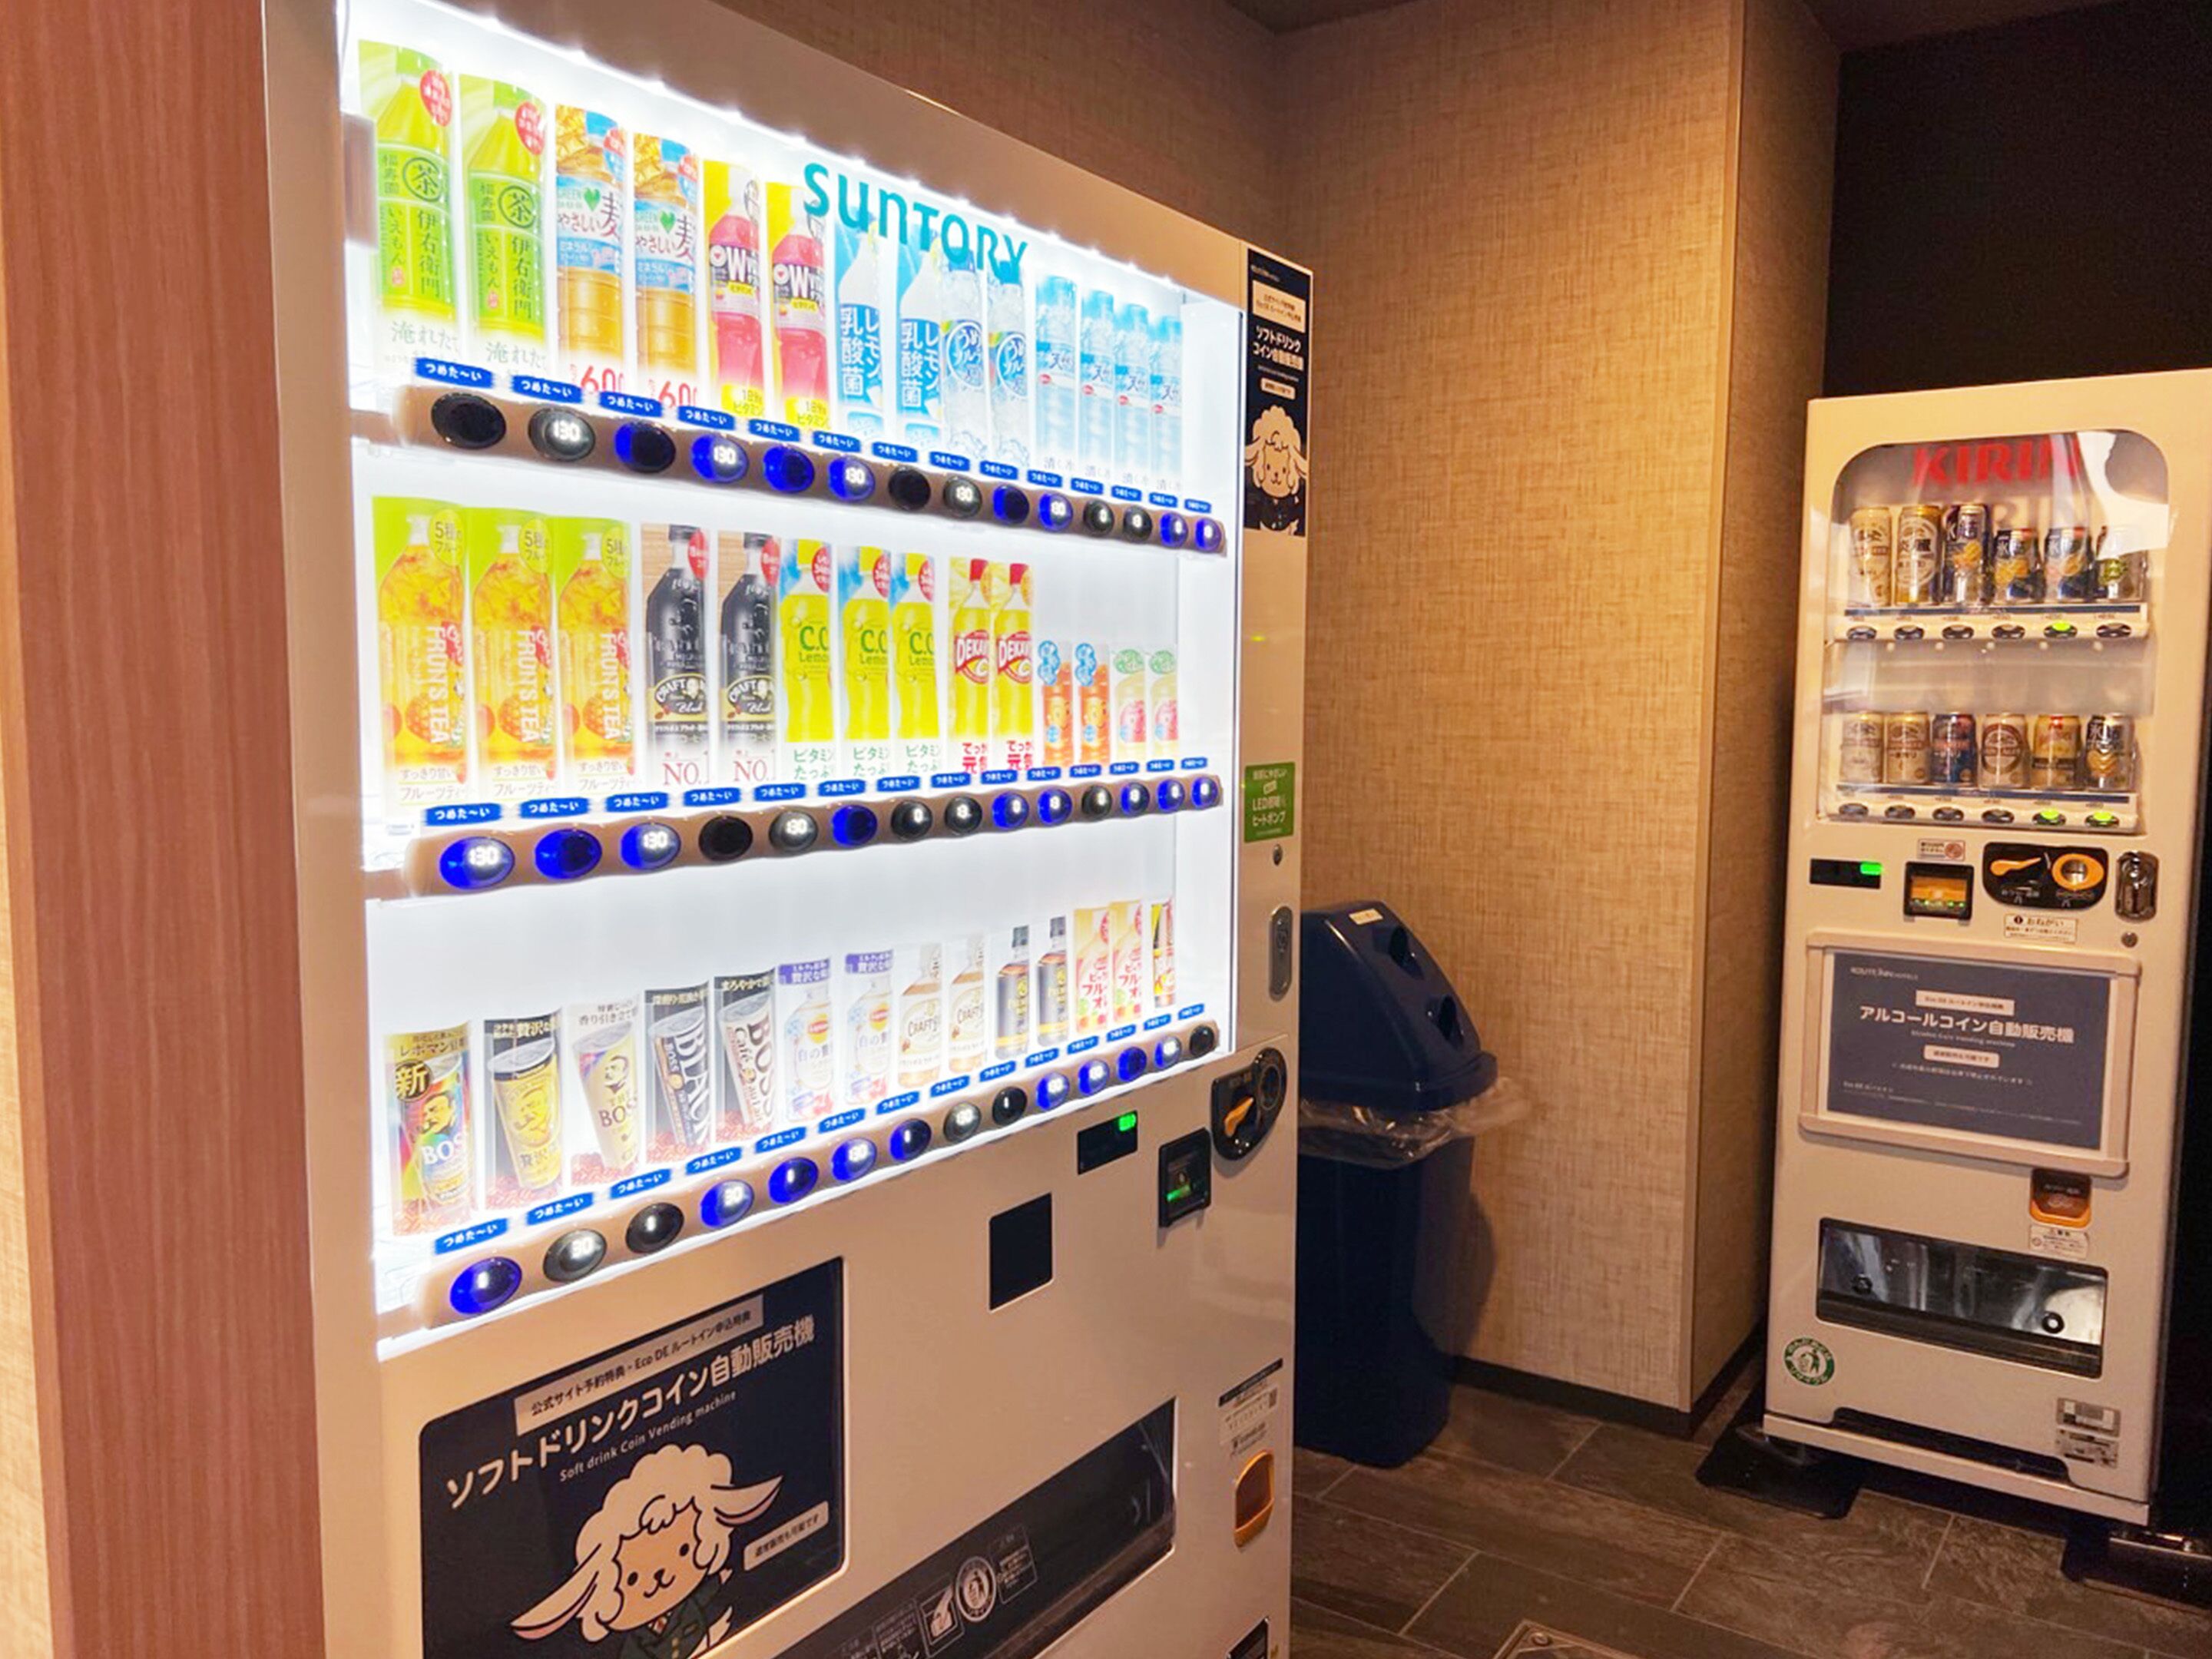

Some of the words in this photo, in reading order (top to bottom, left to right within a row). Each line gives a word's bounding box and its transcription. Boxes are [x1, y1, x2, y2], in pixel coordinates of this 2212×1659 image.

[417, 209, 441, 299] 伊右衛門
[511, 237, 533, 320] 伊右衛門
[840, 307, 864, 396] 乳酸菌
[900, 322, 924, 408] 乳酸菌
[551, 419, 581, 442] 130
[429, 700, 449, 743] TEA
[519, 700, 538, 742] TEA
[603, 700, 621, 740] TEA
[394, 1063, 429, 1099] 新
[446, 1314, 815, 1508] ソフトドリンクコイン自動販売機
[559, 1463, 584, 1482] Soft
[587, 1447, 618, 1472] drink
[620, 1434, 645, 1454] Coin
[648, 1412, 693, 1440] Vending
[694, 1390, 737, 1416] machine
